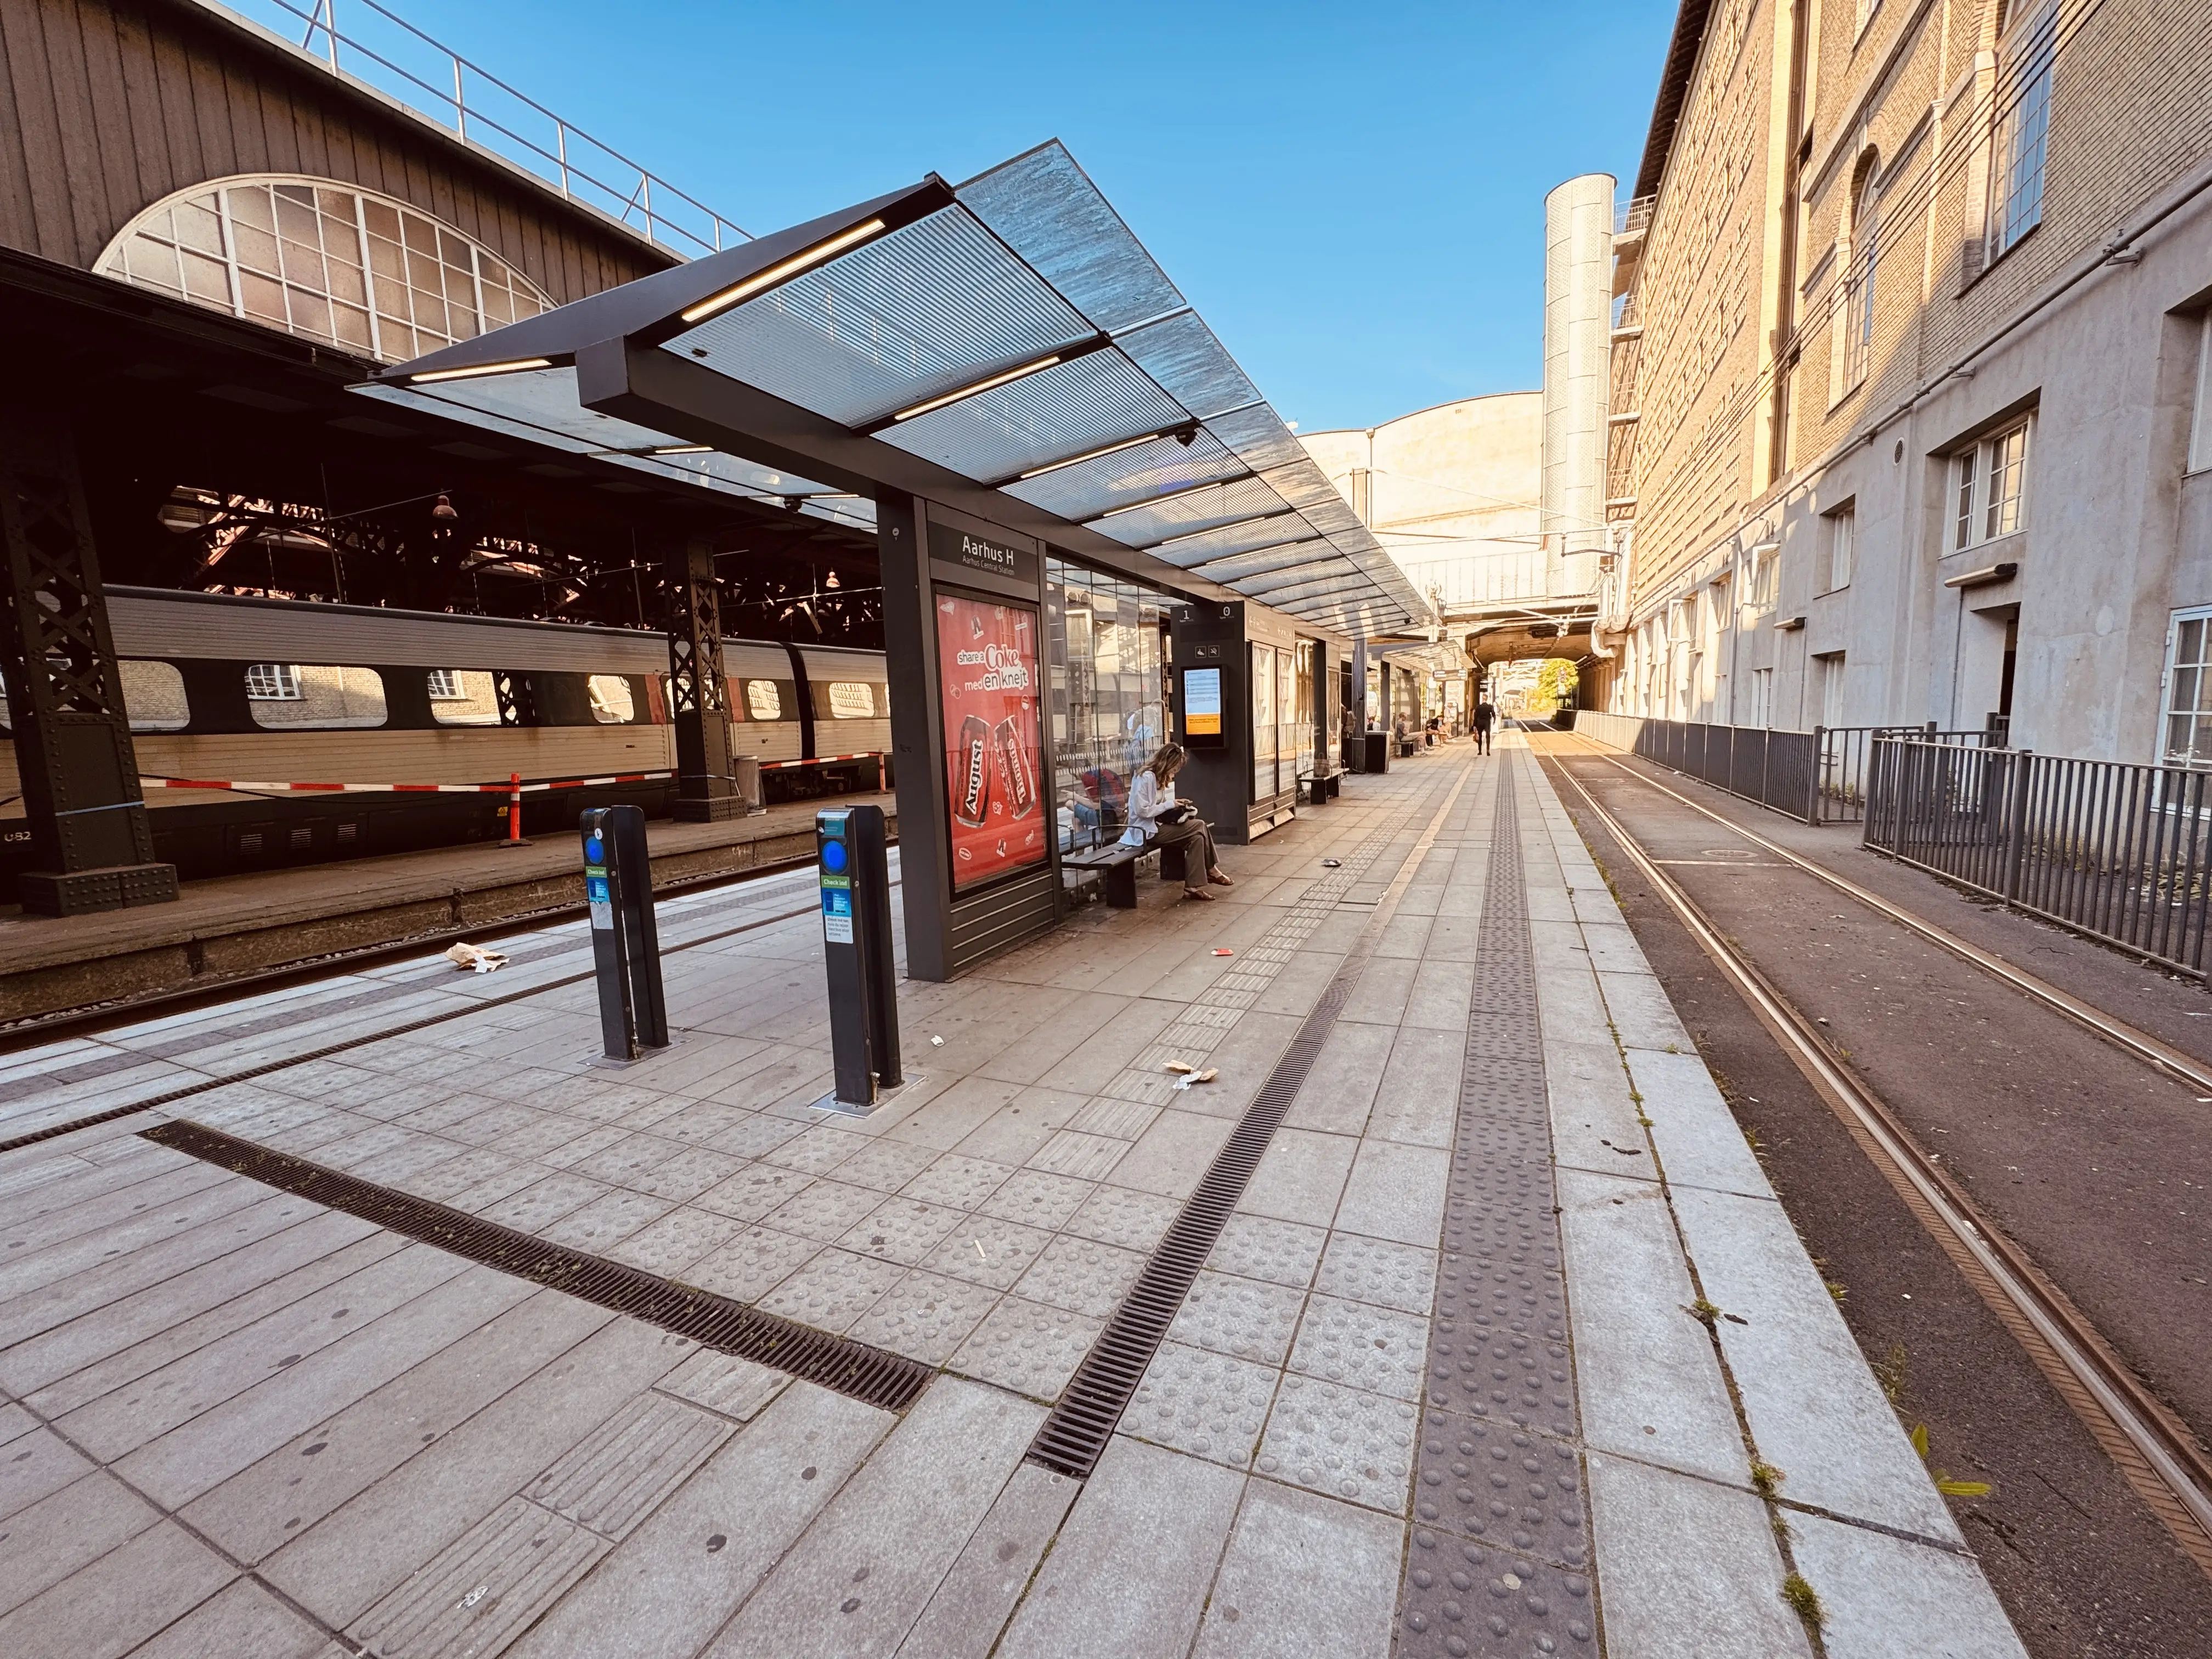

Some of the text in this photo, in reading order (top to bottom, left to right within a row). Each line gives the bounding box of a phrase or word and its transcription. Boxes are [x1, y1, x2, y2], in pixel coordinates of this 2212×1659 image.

[962, 535, 1014, 566] Aarhus H
[962, 555, 1015, 575] Aarhus Central Station
[1183, 610, 1189, 619] 1
[1223, 606, 1231, 616] 0
[958, 645, 1019, 669] share a Coke
[964, 669, 1028, 691] med en knejt
[966, 740, 983, 812] August
[1008, 738, 1025, 803] Thomas
